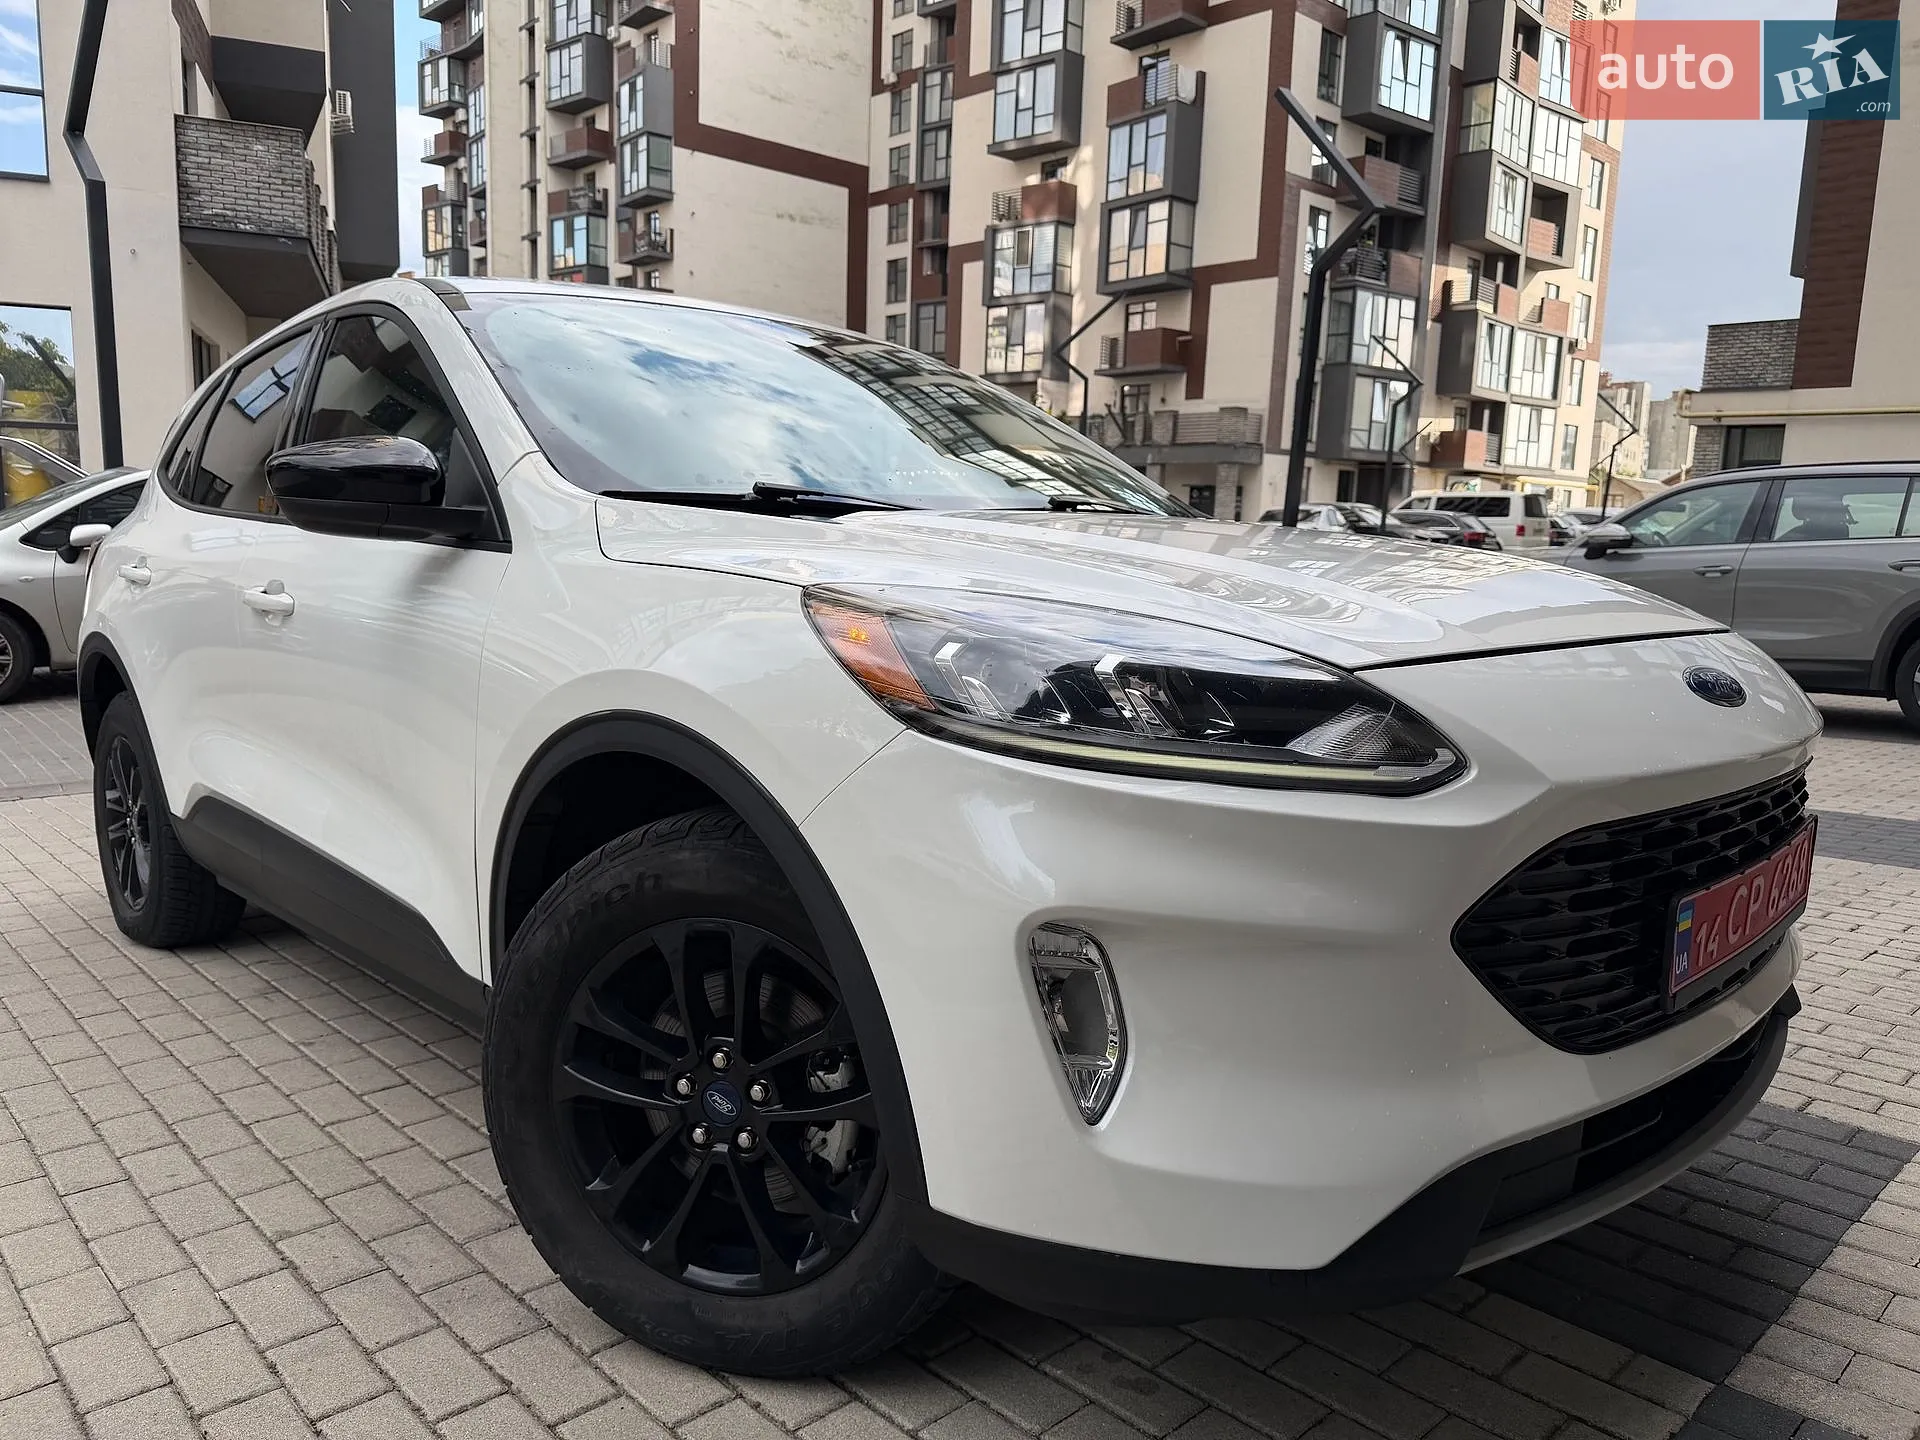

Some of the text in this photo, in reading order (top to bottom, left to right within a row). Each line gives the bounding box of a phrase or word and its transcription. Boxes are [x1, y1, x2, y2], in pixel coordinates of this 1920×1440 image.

[1695, 914, 1722, 968] 14
[1727, 874, 1765, 945] CP
[1675, 954, 1688, 975] UA
